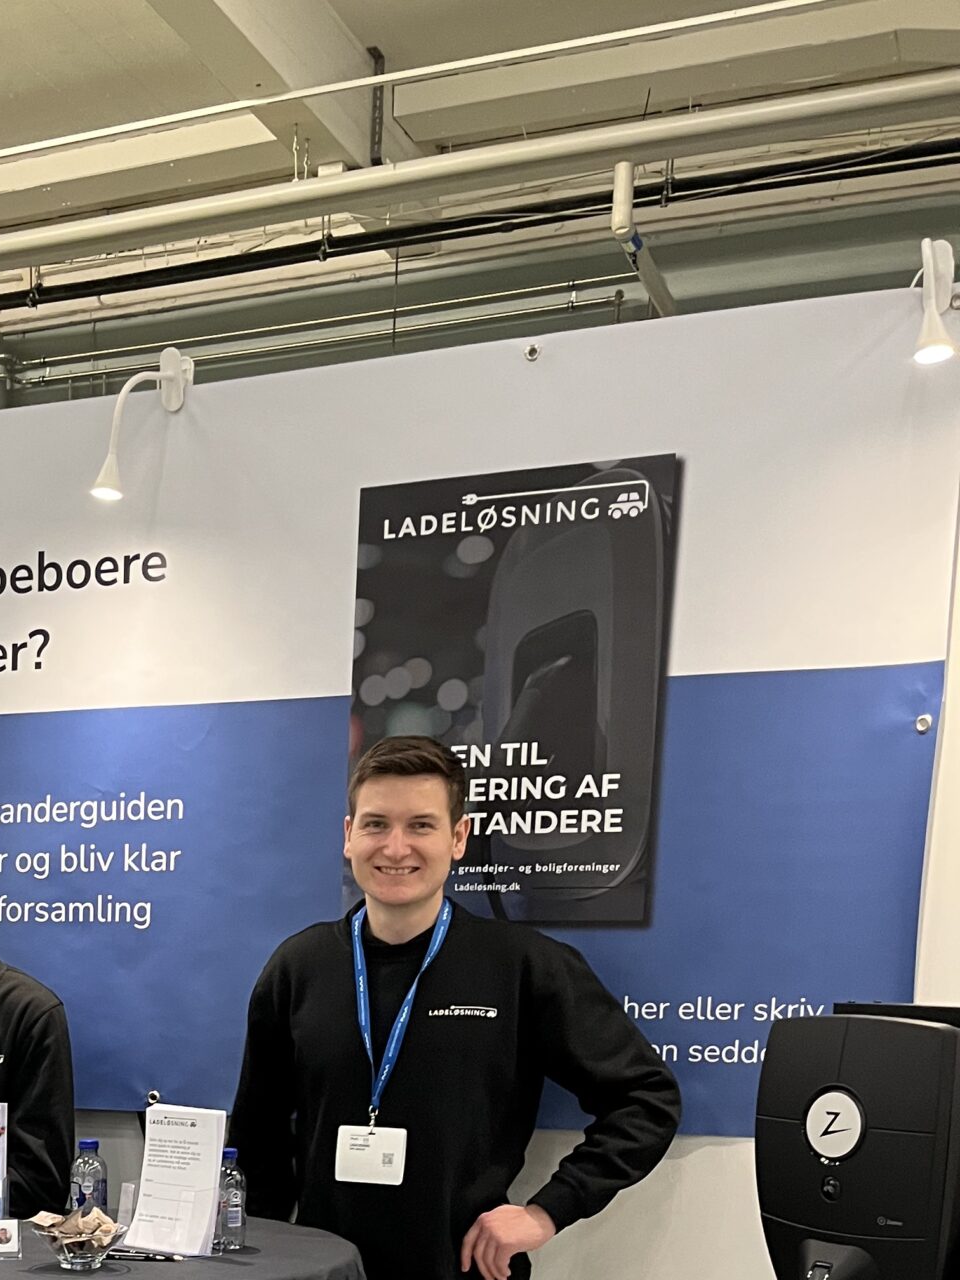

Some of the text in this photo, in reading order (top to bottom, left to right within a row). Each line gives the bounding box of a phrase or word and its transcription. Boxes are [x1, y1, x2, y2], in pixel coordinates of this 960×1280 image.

[383, 498, 600, 539] LADELØSNING
[500, 741, 548, 767] TIL
[464, 773, 621, 802] ERING AF
[16, 852, 50, 879] og
[60, 845, 114, 873] bliv
[123, 845, 182, 873] klar
[518, 865, 532, 874] og
[535, 862, 621, 874] boligforeninger
[624, 995, 825, 1022] her eller skriv
